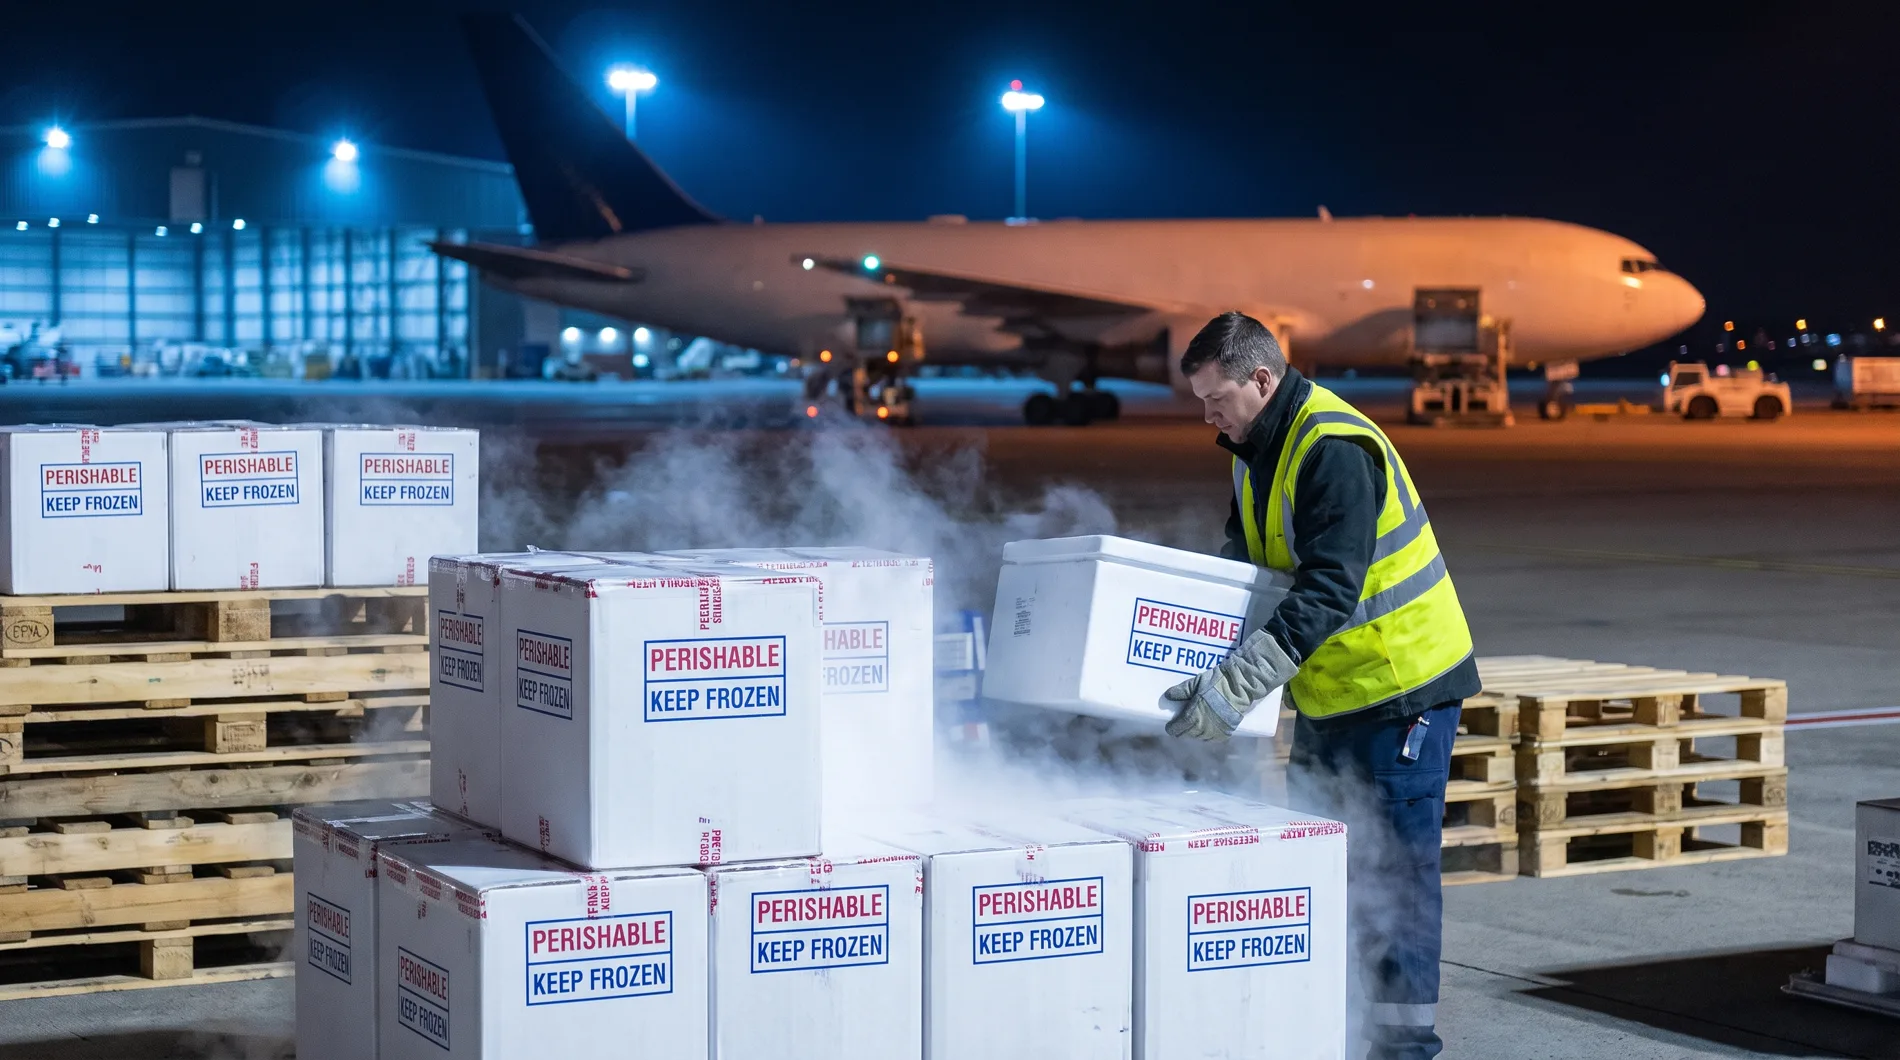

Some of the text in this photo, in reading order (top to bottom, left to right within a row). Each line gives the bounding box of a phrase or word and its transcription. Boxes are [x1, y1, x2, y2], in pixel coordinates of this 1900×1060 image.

[46, 468, 137, 485] PERISHABLE
[205, 457, 293, 475] PERISHABLE
[364, 459, 450, 474] PERISHABLE
[46, 495, 138, 512] KEEP FROZEN
[205, 484, 295, 502] KEEP FROZEN
[364, 485, 450, 500] KEEP FROZEN
[440, 617, 482, 646] PERISHABLE
[1138, 605, 1240, 642] PERISHABLE
[519, 637, 569, 670] PERISHABLE
[824, 628, 883, 650] HABLE
[1132, 639, 1173, 662] KEEP
[440, 655, 482, 683] KEEP FROZEN
[651, 644, 779, 672] PERISHABLE
[519, 677, 570, 710] KEEP FROZEN
[651, 685, 780, 712] KEEP FROZEN
[758, 893, 882, 923] PERISHABLE
[979, 885, 1097, 916] PERISHABLE
[1194, 895, 1305, 925] PERISHABLE
[309, 900, 348, 938] PERISHABLE
[533, 920, 666, 954] PERISHABLE
[758, 934, 882, 964] KEEP FROZEN
[979, 924, 1097, 955] KEEP FROZEN
[1193, 933, 1305, 962] KEEP FROZEN
[310, 938, 349, 976] KEEP FROZEN
[400, 956, 447, 1001] PERISHABLE
[533, 962, 666, 996] KEEP FROZEN
[400, 995, 447, 1041] KEEP FROZEN
